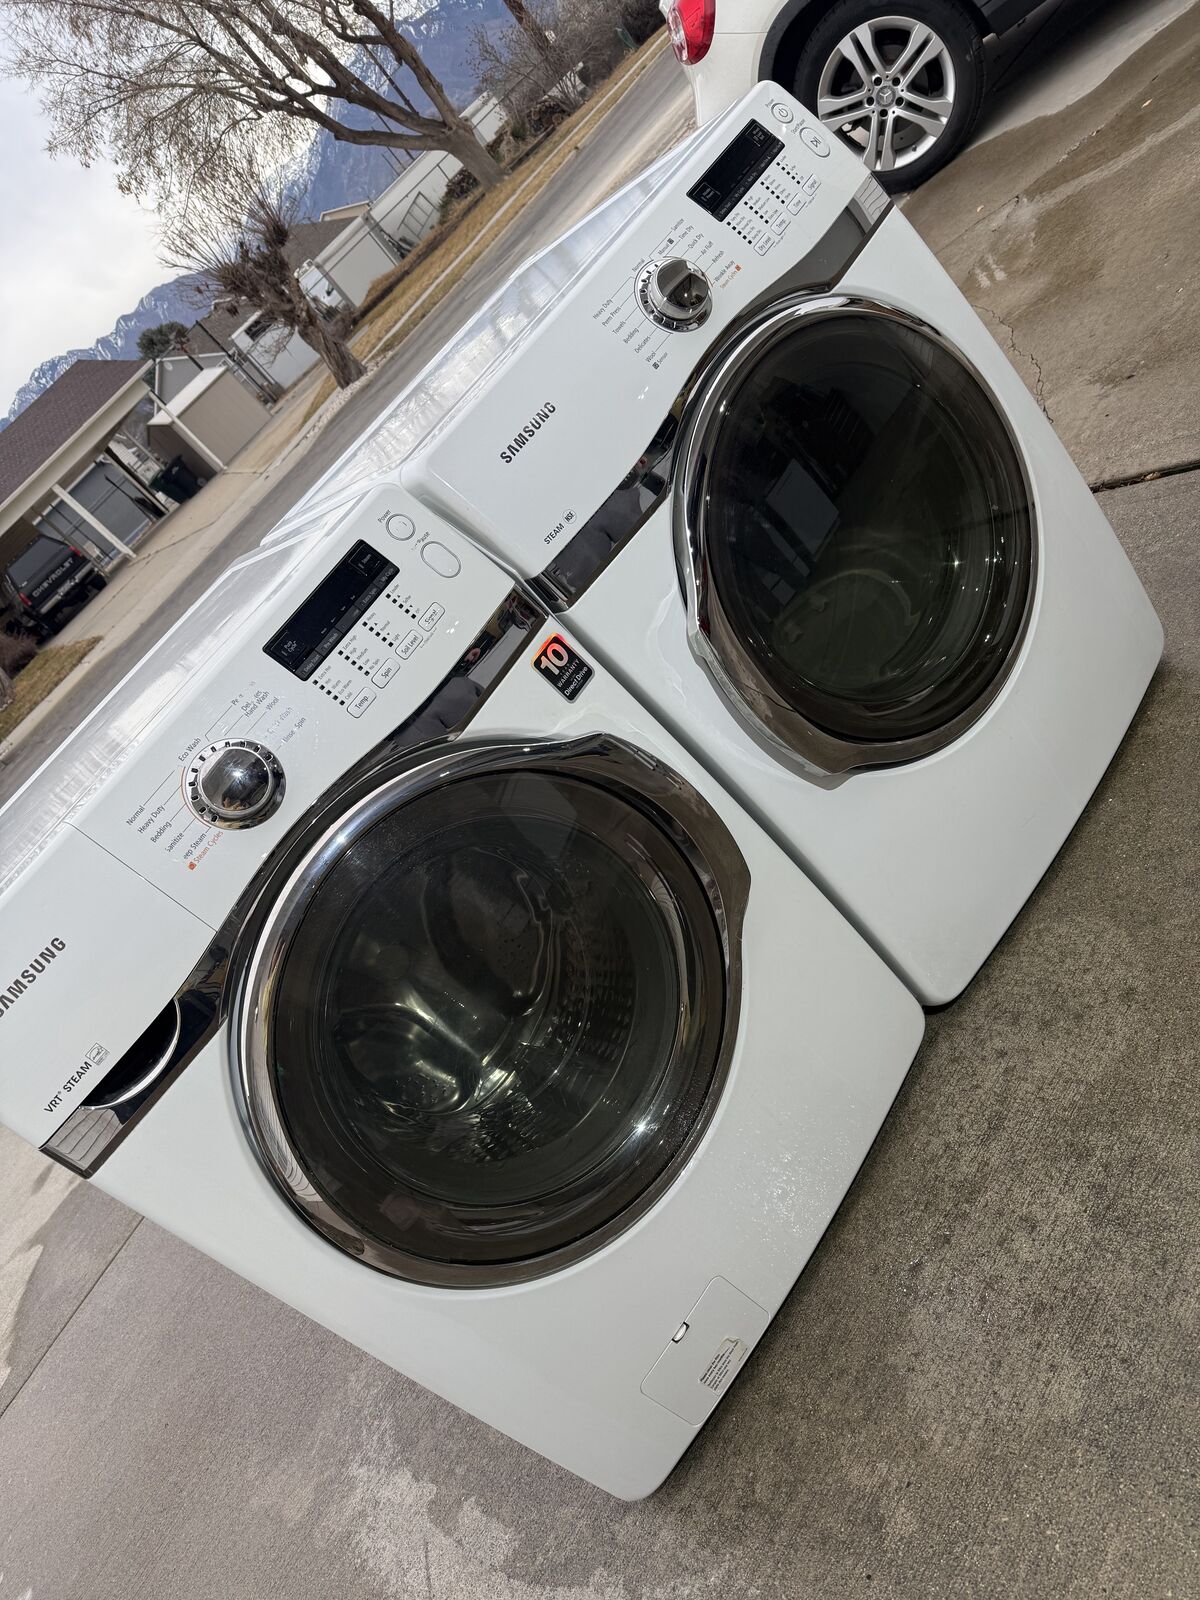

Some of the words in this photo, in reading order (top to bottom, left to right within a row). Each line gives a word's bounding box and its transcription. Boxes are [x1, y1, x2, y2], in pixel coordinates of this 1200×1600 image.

[686, 224, 694, 233] Dry
[688, 238, 698, 249] Quick
[696, 232, 704, 241] Dry
[632, 258, 645, 272] Normal
[593, 307, 606, 320] Heavy
[602, 298, 613, 309] Duty
[602, 315, 613, 327] Perm
[610, 306, 621, 317] Press
[612, 320, 626, 335] Towels
[624, 327, 640, 345] Bedding
[635, 336, 651, 353] Delicates
[646, 351, 656, 362] Wool
[500, 401, 556, 464] SAMSUNG
[378, 508, 391, 523] Power
[543, 522, 565, 545] STEAM
[32, 557, 74, 598] CHEVROLET
[356, 647, 368, 660] Medium
[401, 645, 410, 655] Soil
[407, 635, 419, 647] Level
[540, 643, 569, 676] 10
[381, 666, 394, 679] Spin
[557, 658, 580, 688] WARRANTY
[564, 679, 579, 696] Direct
[575, 666, 589, 681] Drive
[244, 703, 258, 718] Hand
[256, 690, 270, 705] Wash
[266, 696, 280, 711] Wool
[294, 716, 307, 730] Spin
[178, 750, 189, 762] Eco
[186, 737, 202, 753] Wash
[126, 805, 146, 826] Normal
[138, 817, 155, 835] Heavy
[151, 804, 166, 819] Duty
[150, 820, 172, 844] Bedding
[182, 849, 195, 861] eep
[190, 832, 207, 850] Steam
[193, 846, 210, 863] Steam
[207, 829, 225, 848] Cycles
[62, 1060, 93, 1093] STEAM
